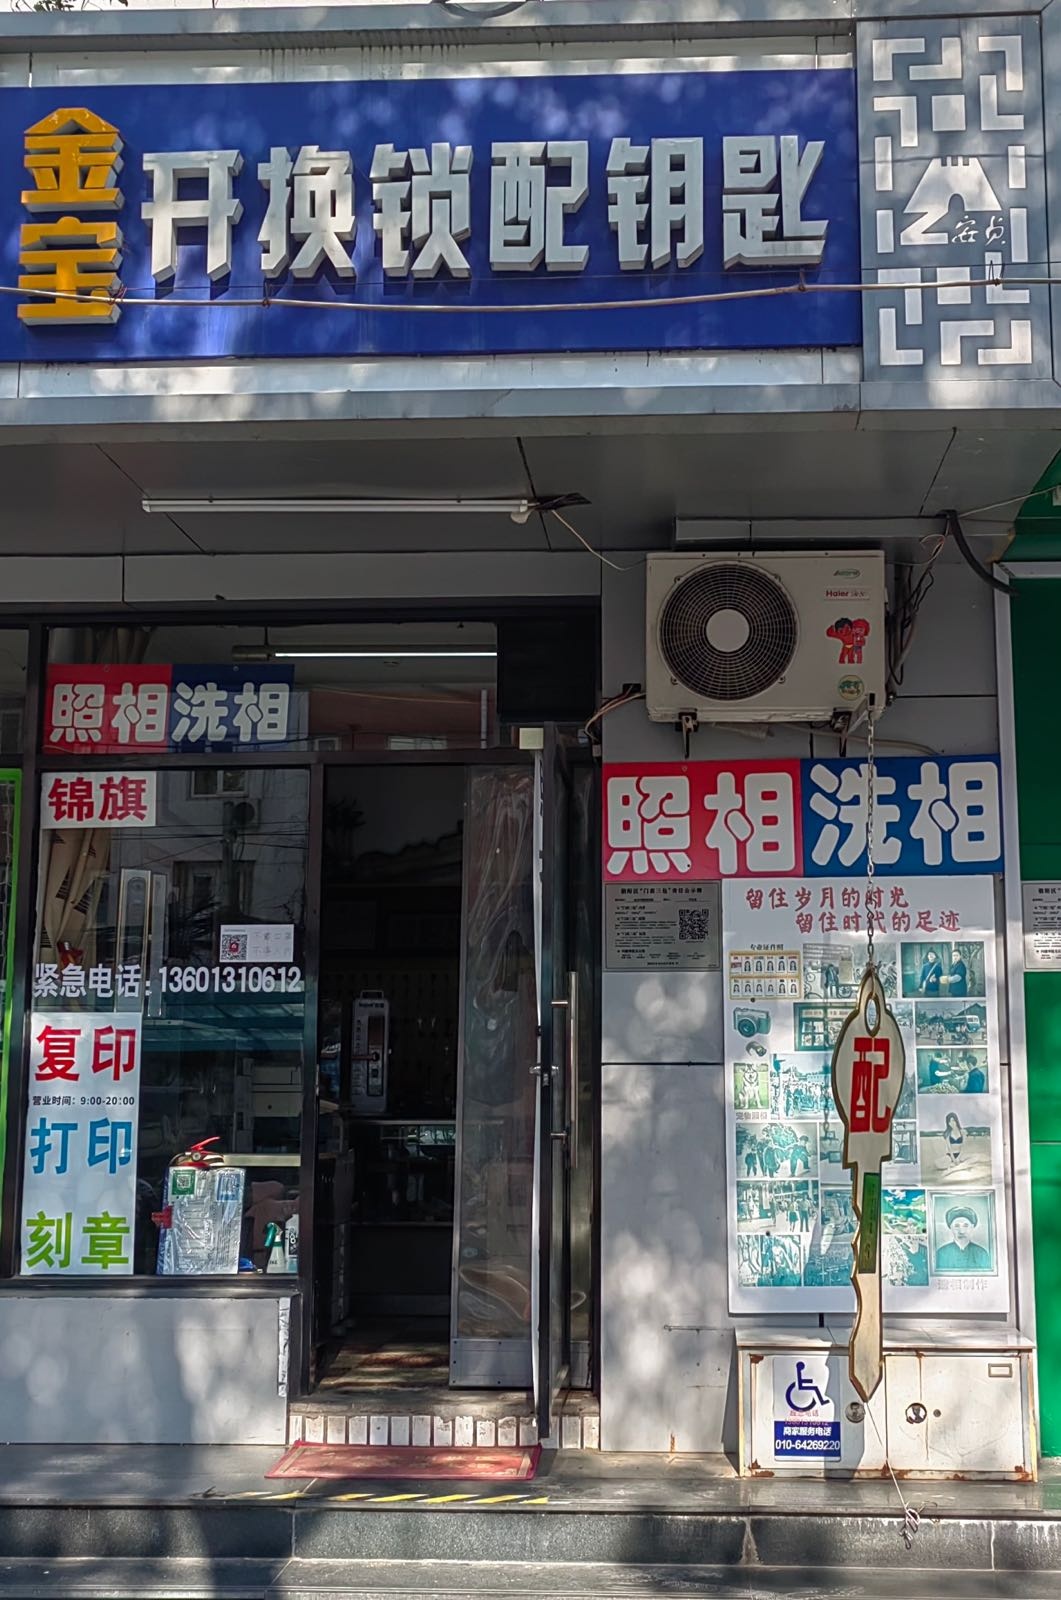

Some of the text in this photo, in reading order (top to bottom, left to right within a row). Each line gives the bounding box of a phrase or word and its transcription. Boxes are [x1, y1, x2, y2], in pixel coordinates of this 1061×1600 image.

[17, 107, 125, 326] 金宝
[141, 134, 830, 283] 开换锁配钥匙
[49, 681, 291, 744] 照相洗相
[48, 776, 148, 822] 锦旗
[606, 760, 1002, 876] 照相洗相
[745, 885, 910, 912] 留住岁月的时光
[795, 909, 961, 934] 留住时代的足迹
[34, 1025, 137, 1082] 复印
[849, 1037, 891, 1133] 配
[30, 1117, 133, 1175] 打印
[25, 1211, 131, 1270] 刻章
[774, 1439, 841, 1451] 010-64269220
